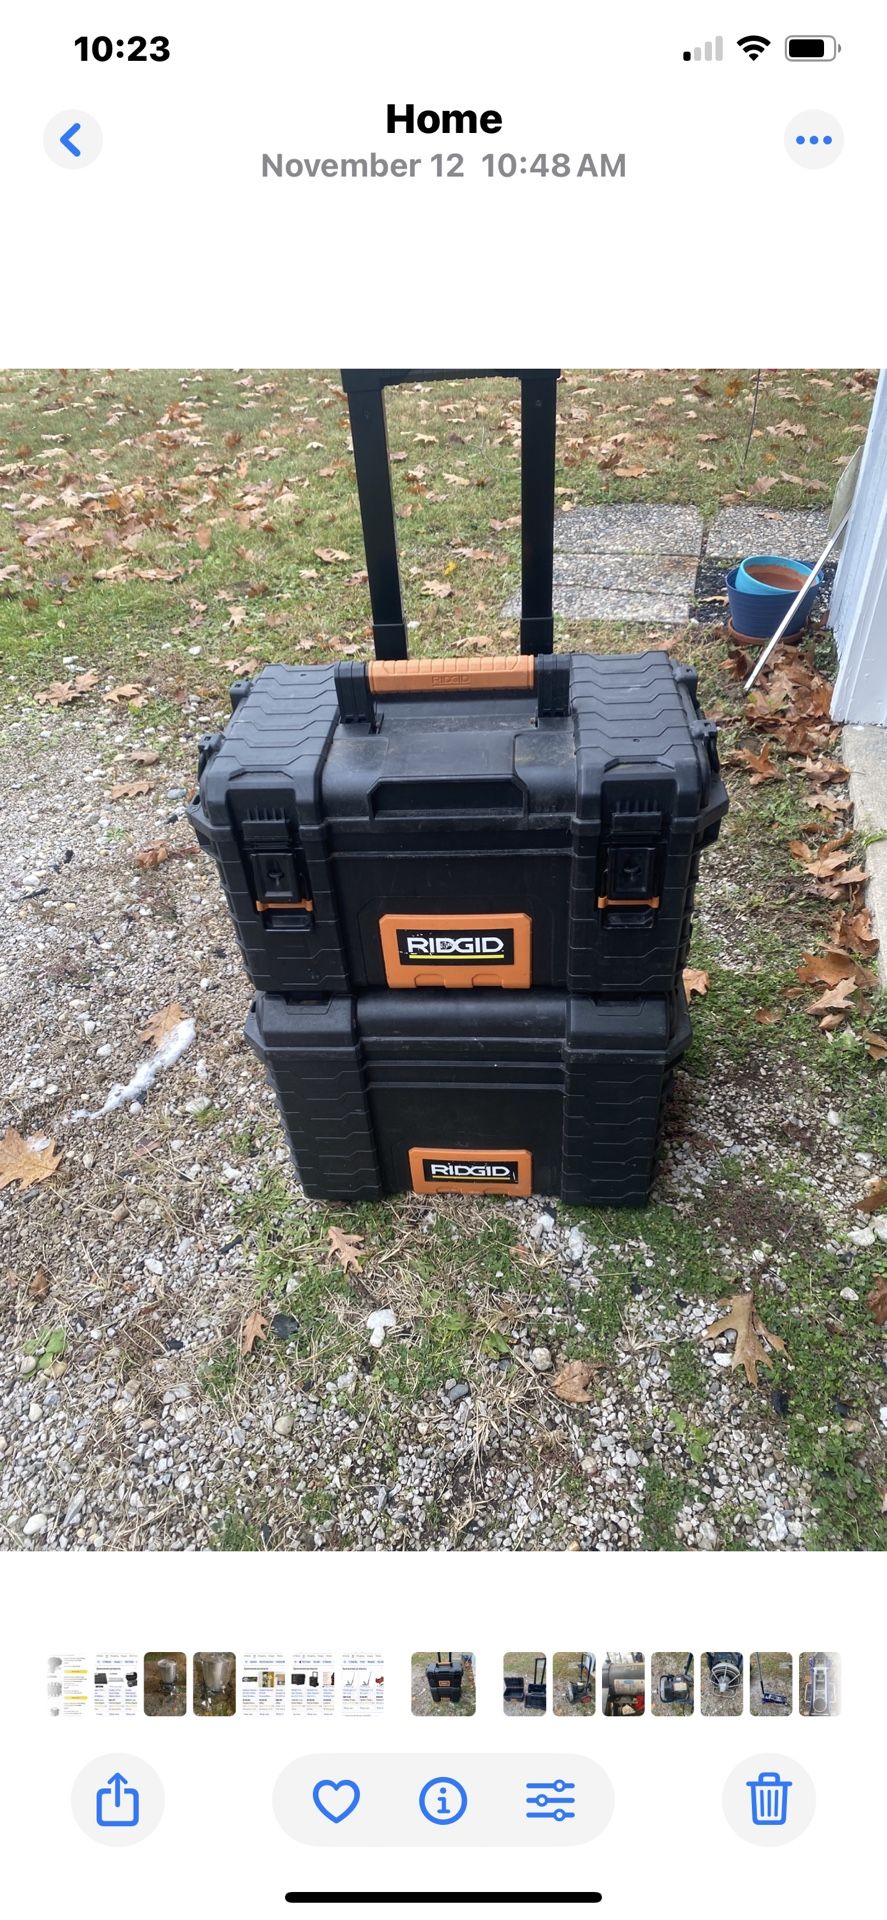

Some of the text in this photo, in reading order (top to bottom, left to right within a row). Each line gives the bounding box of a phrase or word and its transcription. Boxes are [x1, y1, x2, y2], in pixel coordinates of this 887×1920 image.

[74, 35, 171, 63] 10:23
[386, 103, 503, 135] Home
[262, 152, 626, 178] November 12 10:48 AM
[431, 675, 471, 686] RIDGID
[406, 936, 504, 954] RIDGID
[430, 1163, 511, 1177] RIDGID
